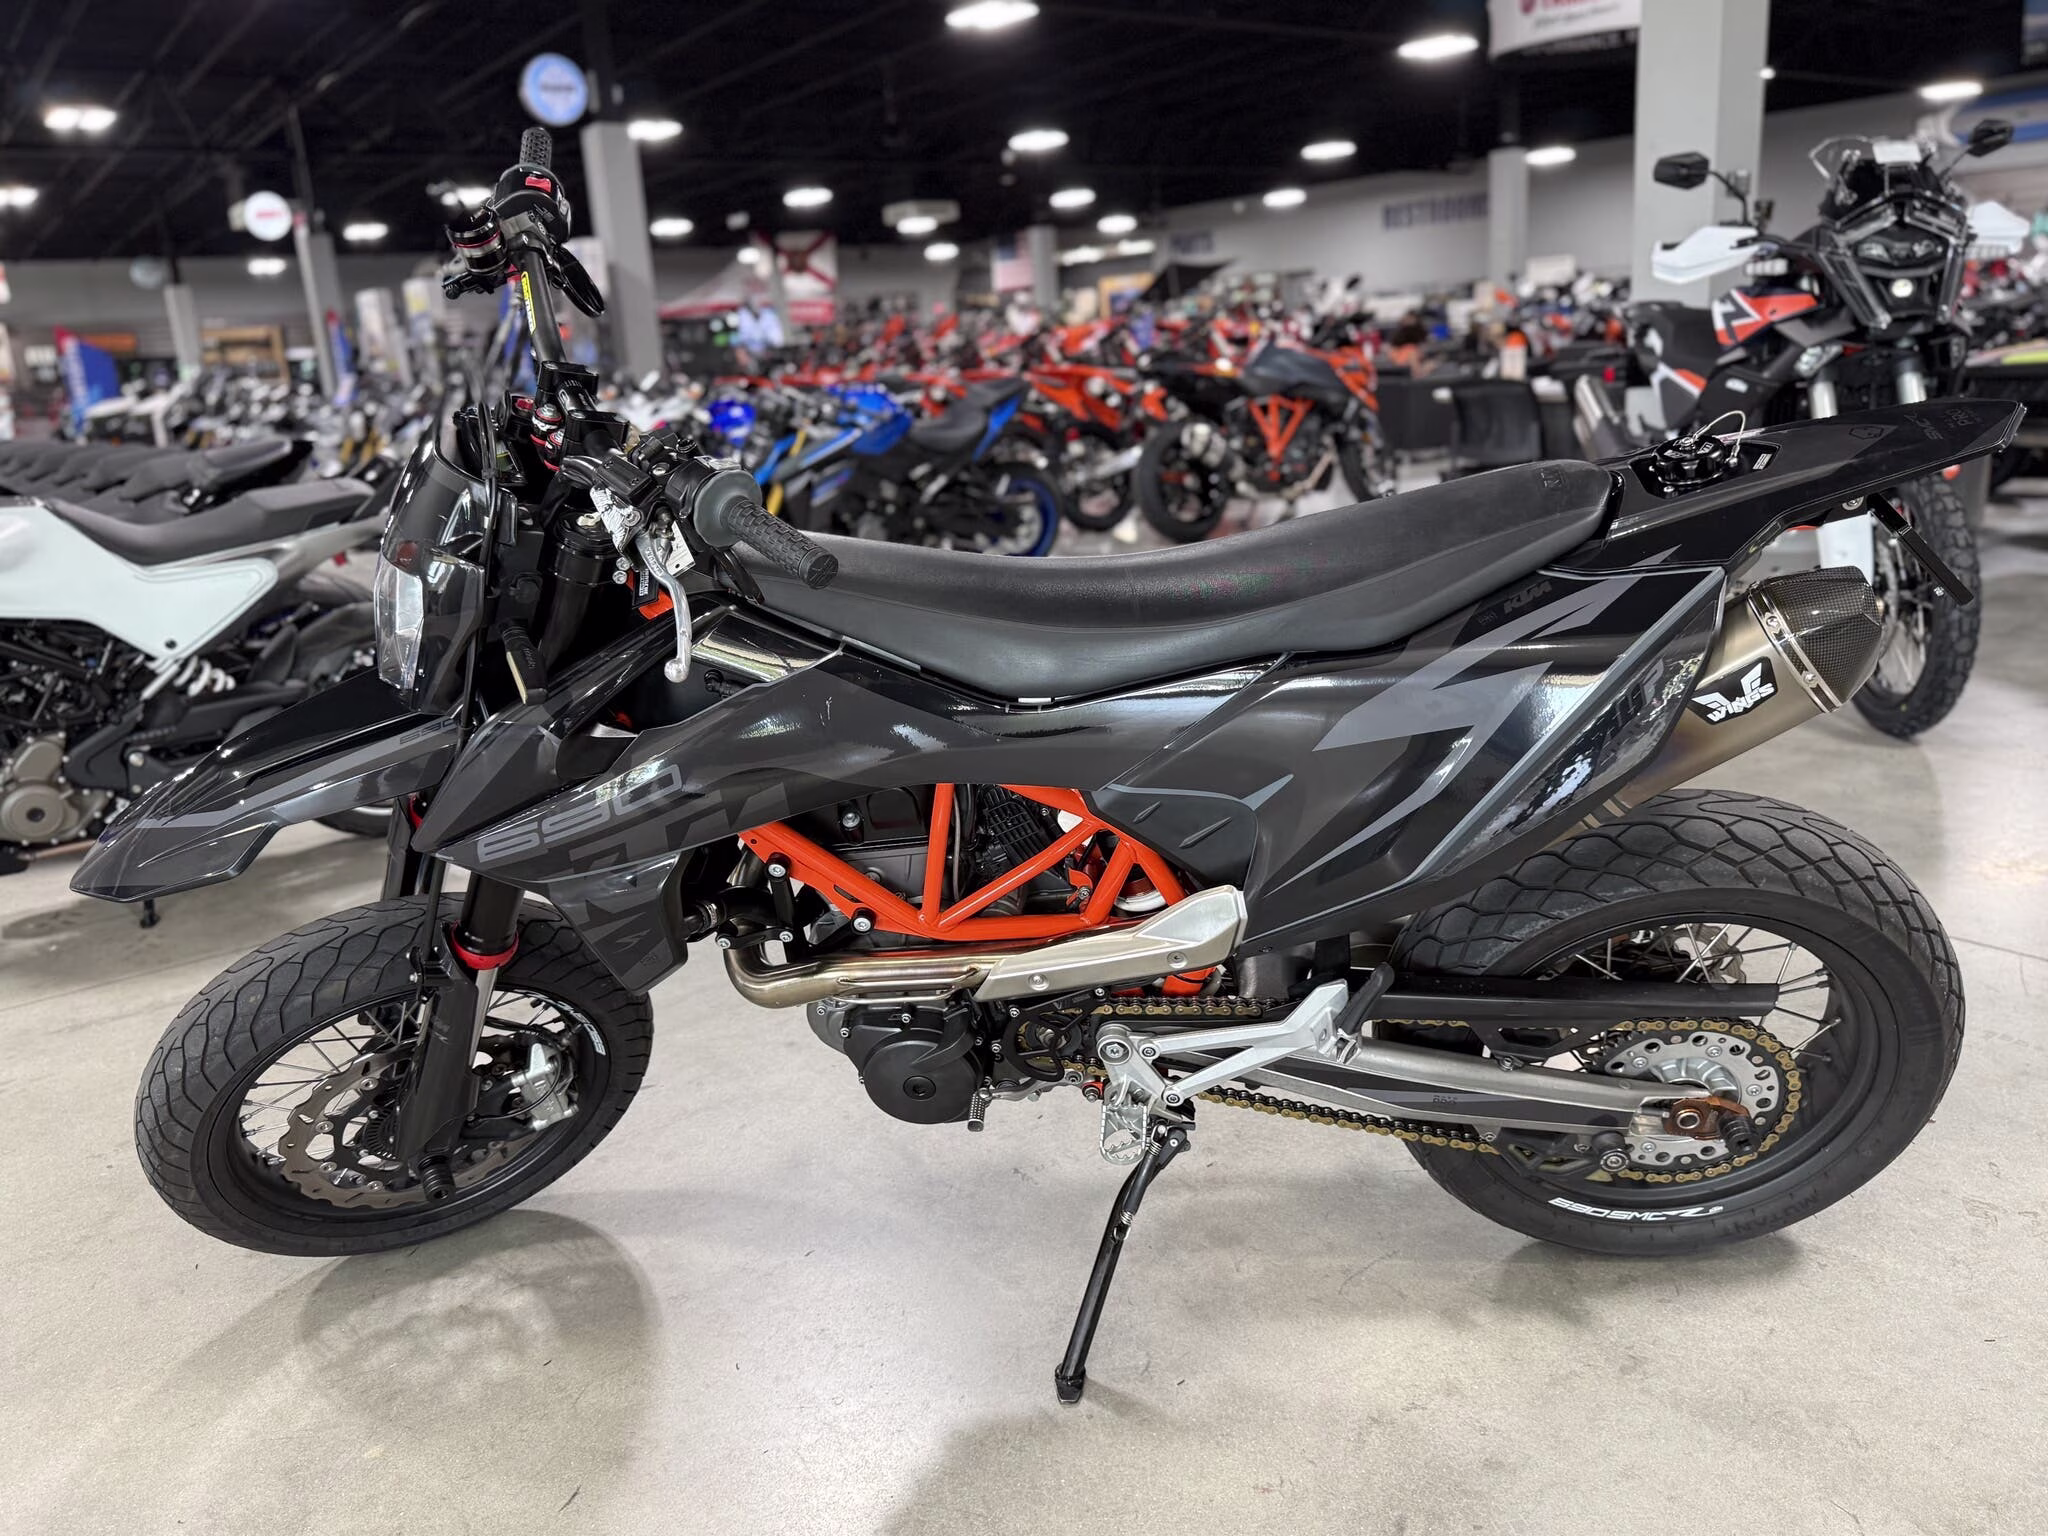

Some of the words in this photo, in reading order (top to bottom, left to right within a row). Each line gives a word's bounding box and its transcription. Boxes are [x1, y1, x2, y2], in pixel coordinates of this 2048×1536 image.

[1503, 581, 1553, 614] KTM
[1706, 682, 1775, 722] WINGS
[476, 763, 684, 864] 690
